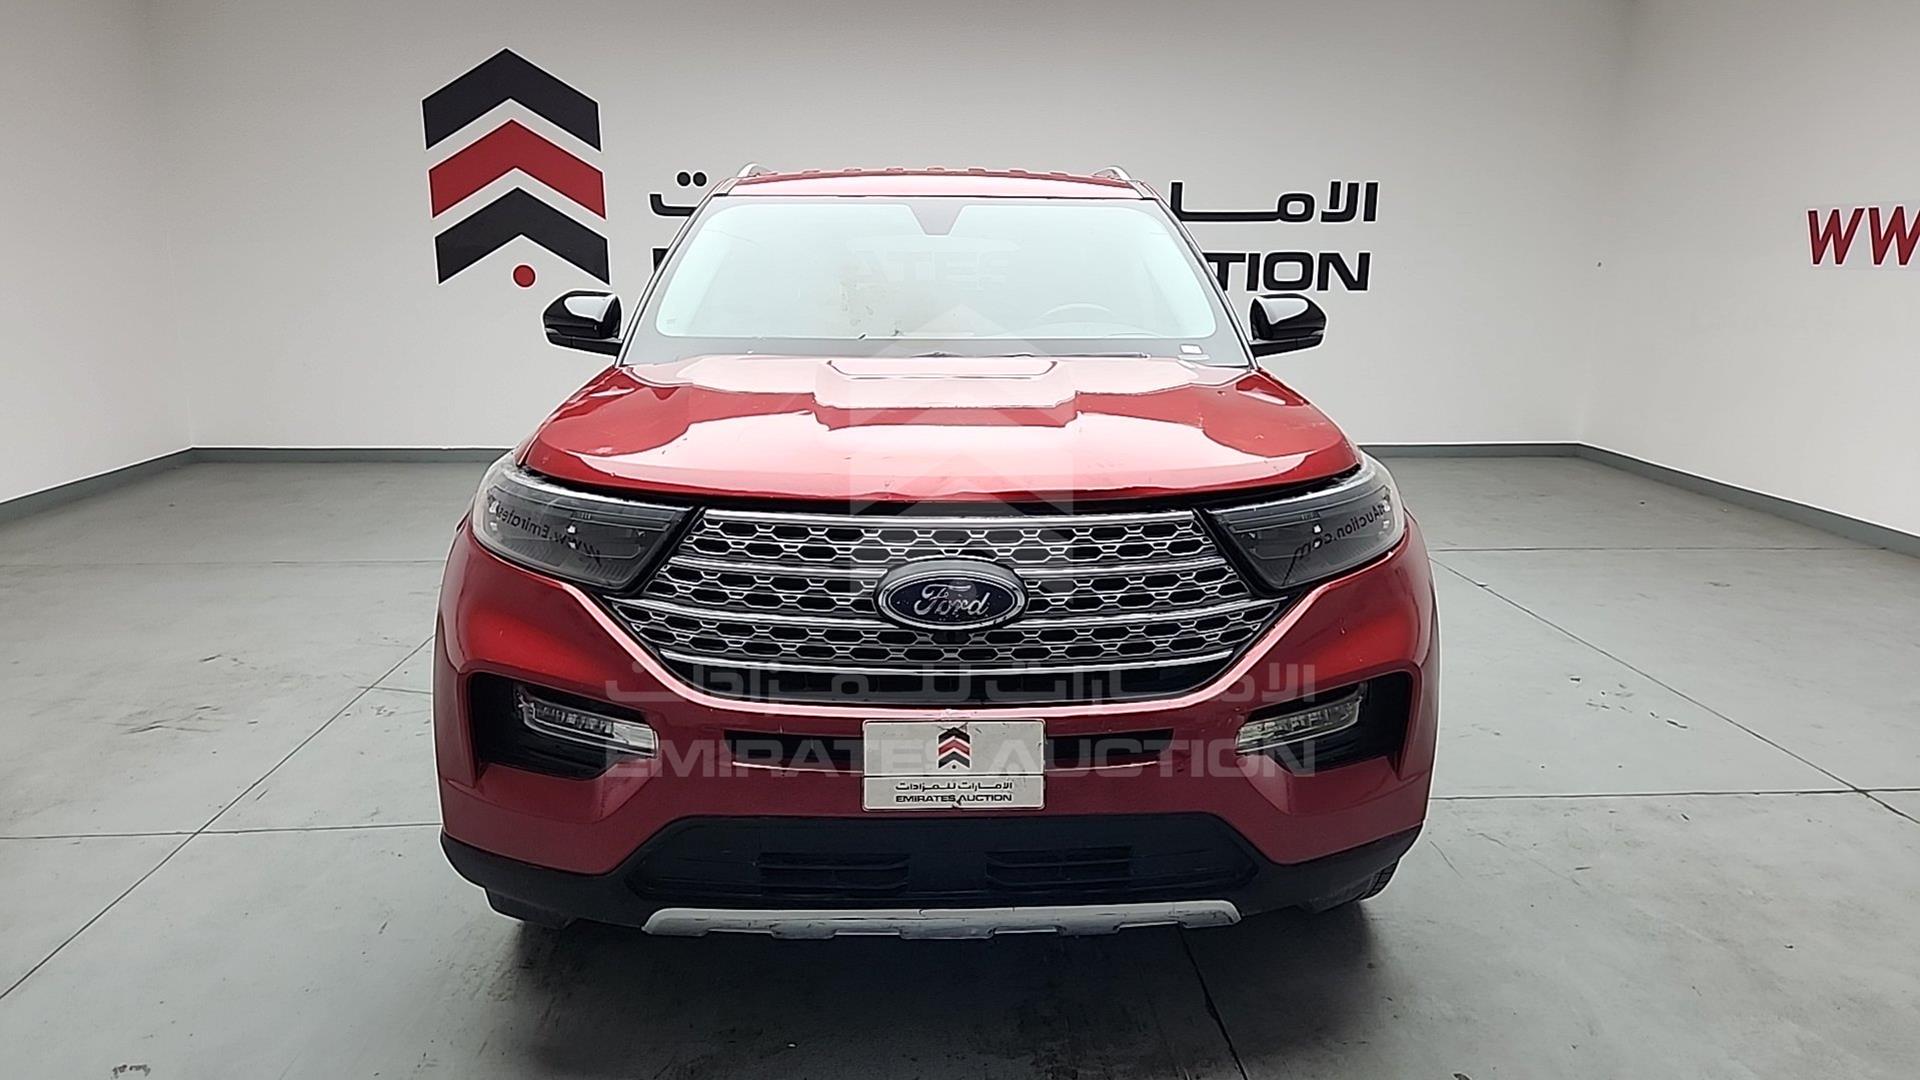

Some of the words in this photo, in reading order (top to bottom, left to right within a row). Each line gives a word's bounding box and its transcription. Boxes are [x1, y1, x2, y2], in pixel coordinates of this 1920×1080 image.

[1202, 252, 1371, 291] TION
[914, 583, 991, 616] Ford
[895, 795, 955, 803] EMIRATES
[958, 794, 1012, 803] AUCTION
